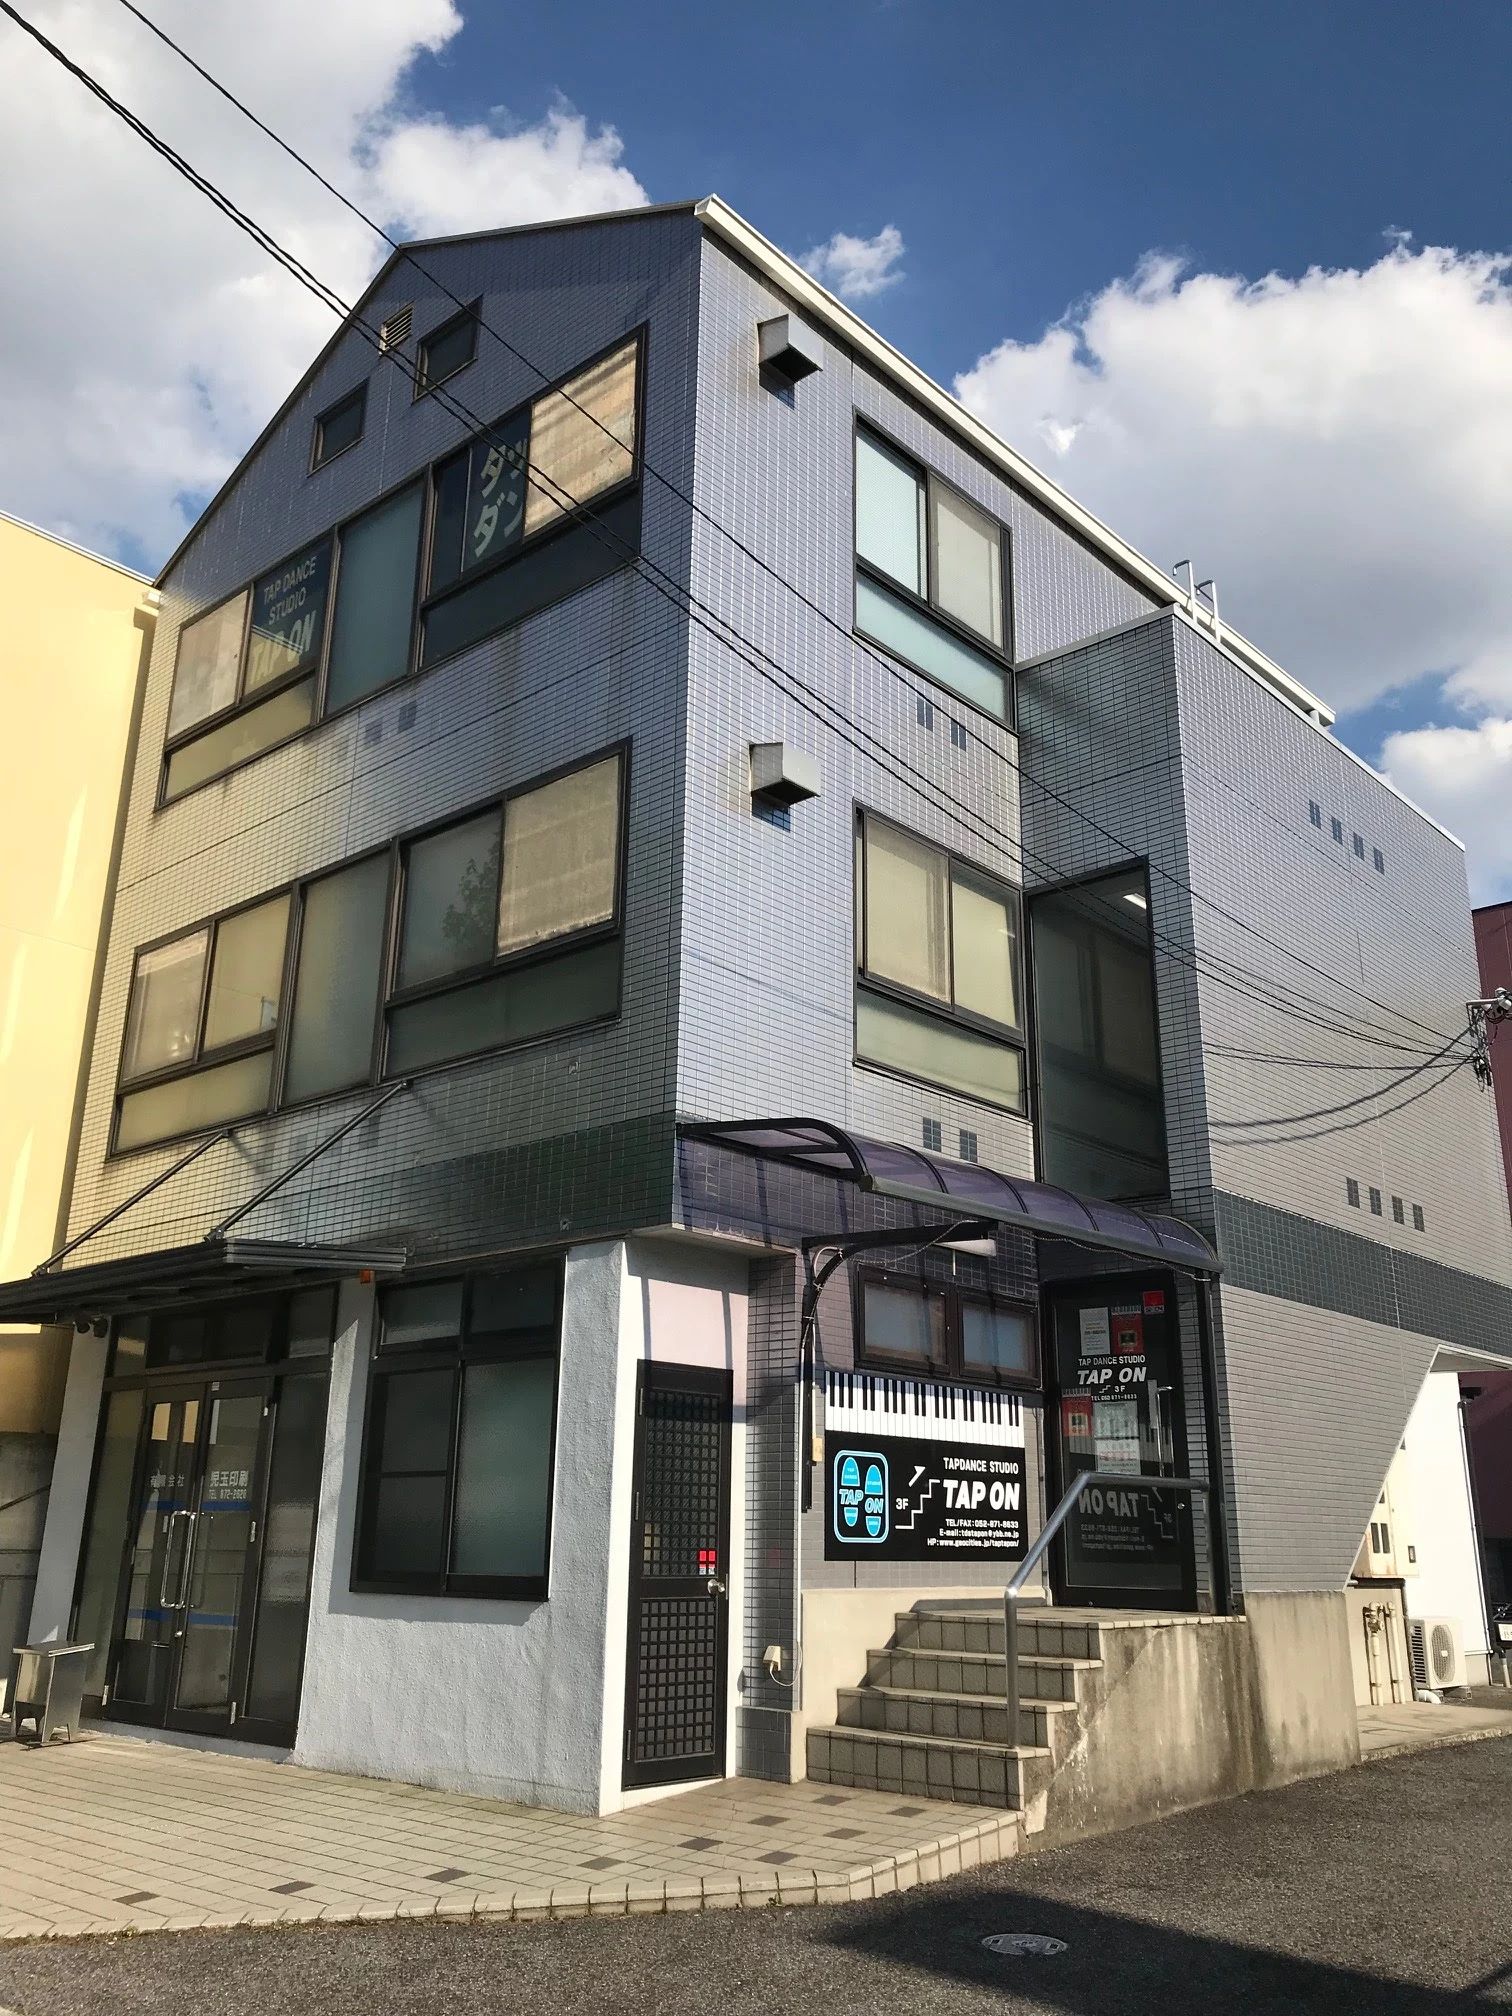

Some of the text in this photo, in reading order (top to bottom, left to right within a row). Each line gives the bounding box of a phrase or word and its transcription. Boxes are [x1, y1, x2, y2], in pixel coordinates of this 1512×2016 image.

[264, 556, 317, 606] TAP DANCE
[269, 586, 307, 625] STUDIO
[250, 610, 316, 685] TAP ON
[1078, 1355, 1146, 1366] TAP DANCE STUDIO
[1077, 1366, 1147, 1385] TAP ON
[943, 1457, 1019, 1475] TAPDANCE STUDIO
[839, 1488, 864, 1505] TAP
[895, 1497, 909, 1510] 3F
[943, 1478, 1020, 1511] TAP ON
[864, 1497, 884, 1514] ON
